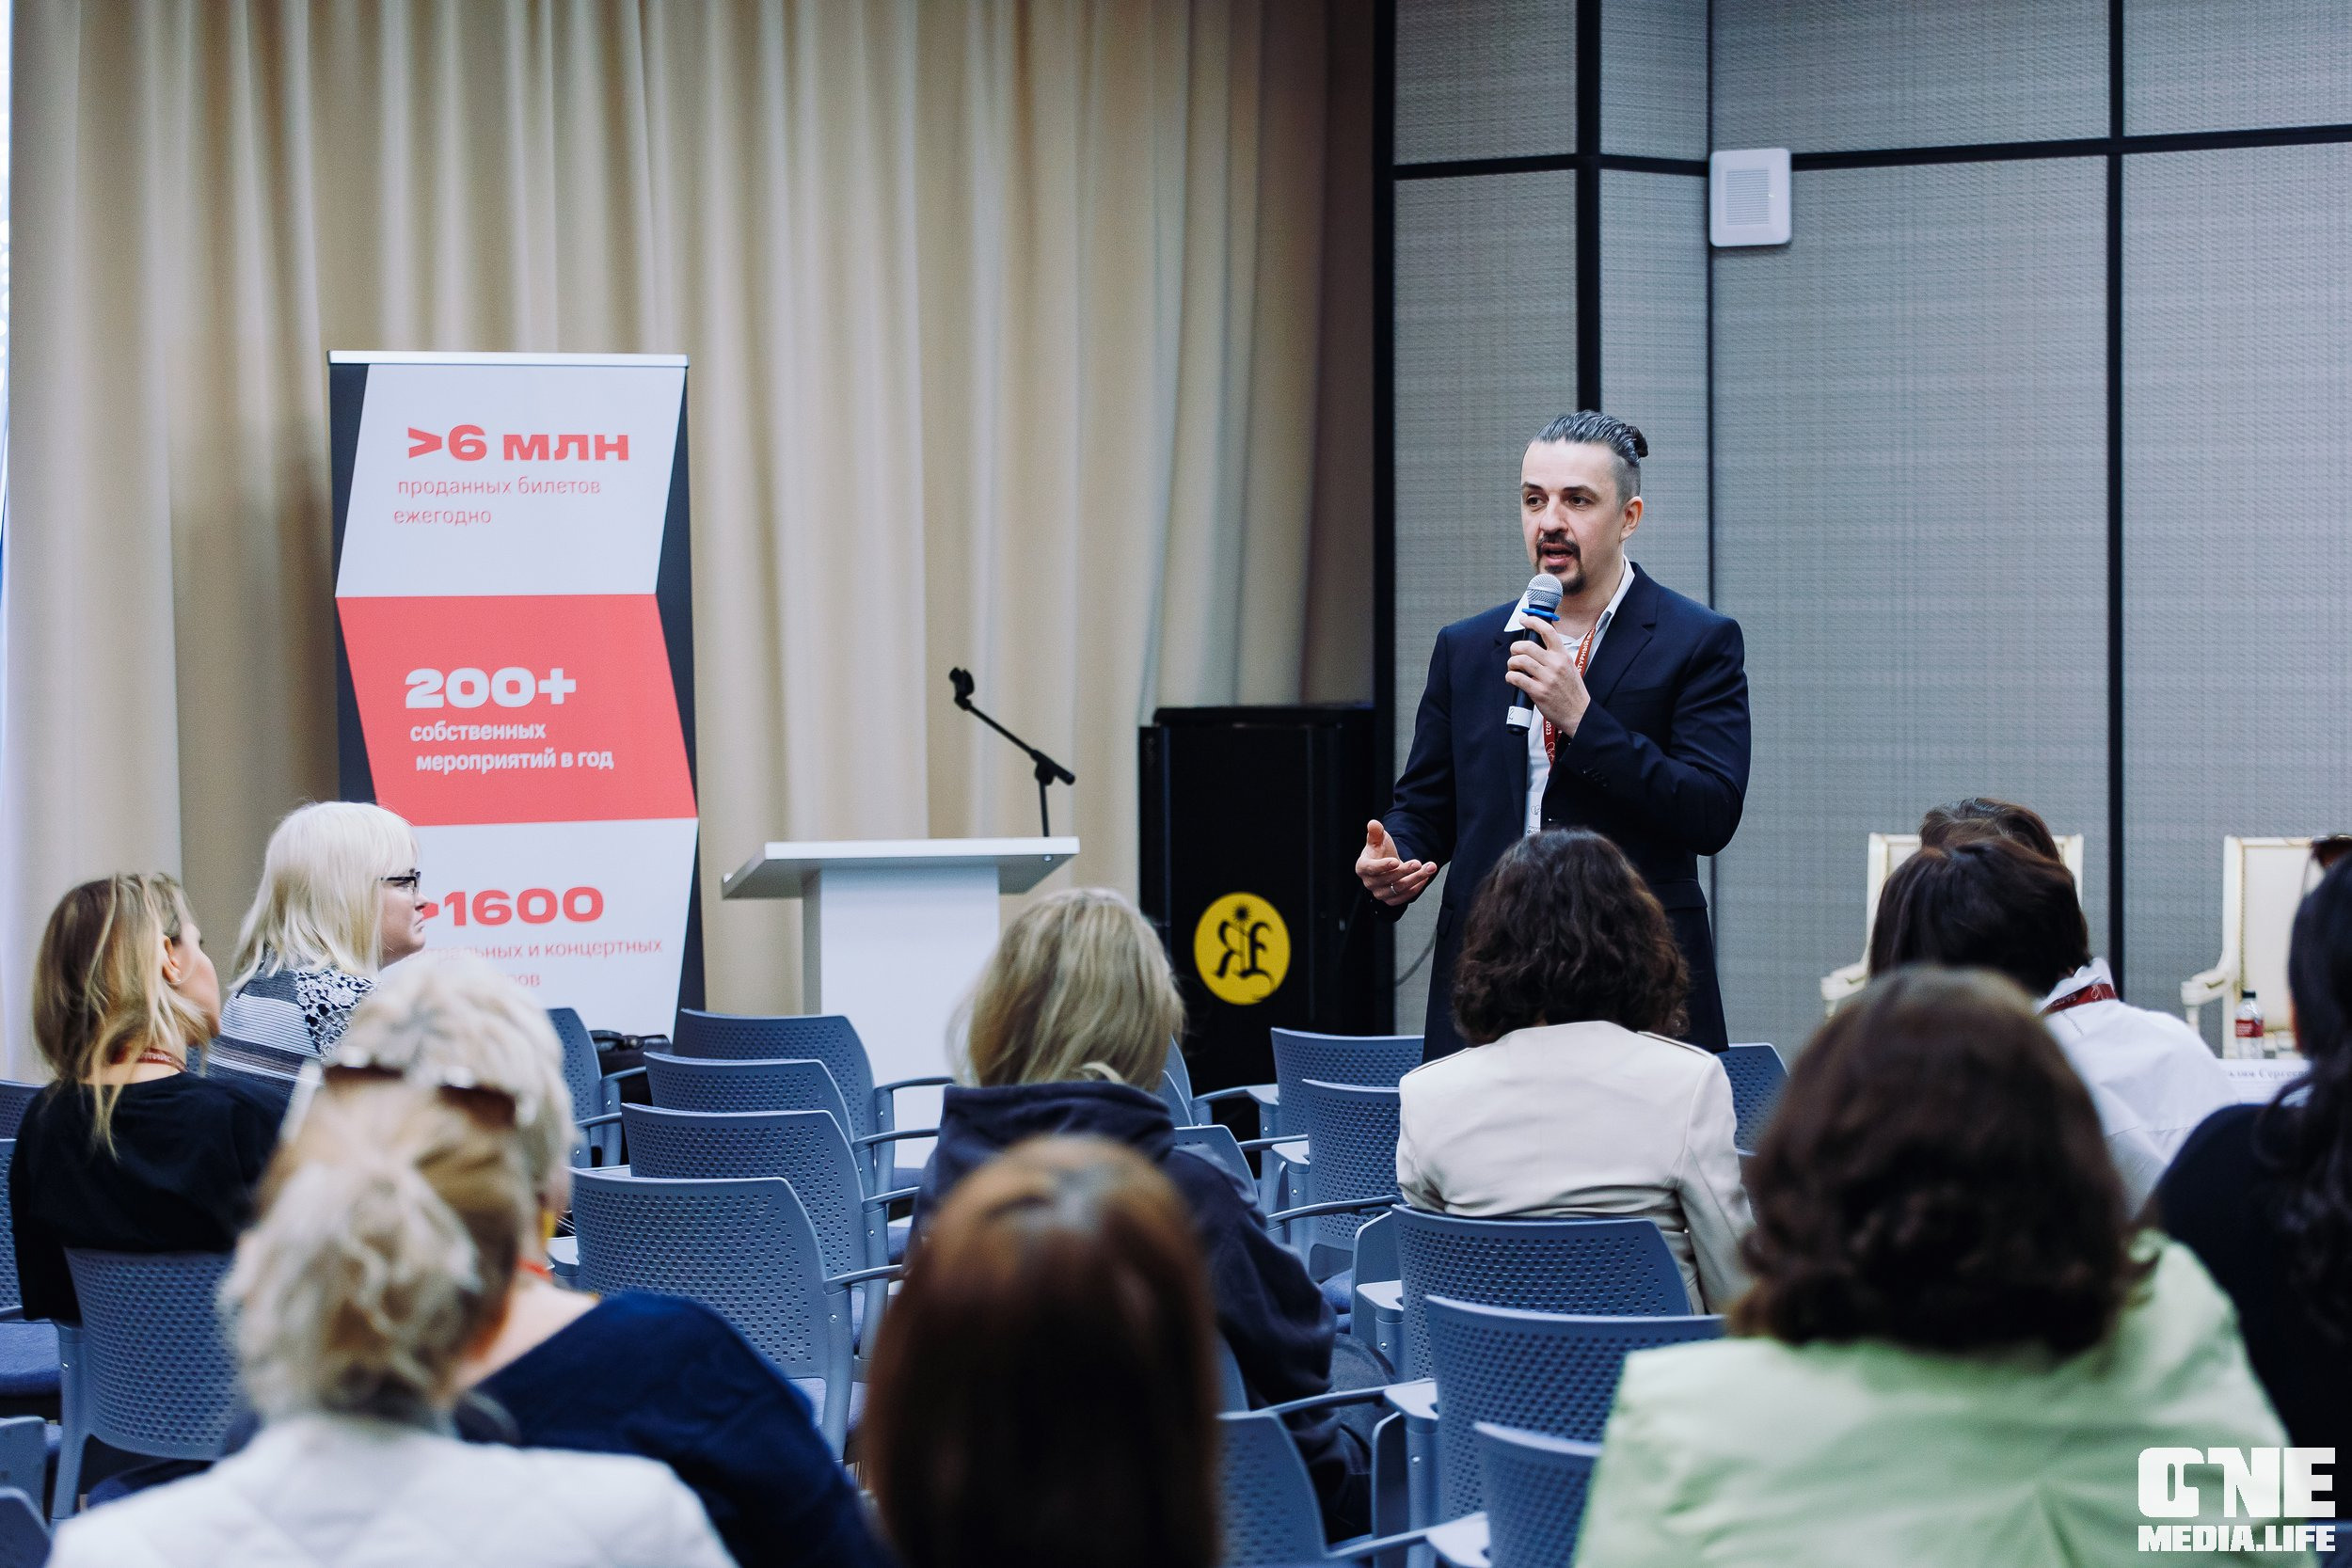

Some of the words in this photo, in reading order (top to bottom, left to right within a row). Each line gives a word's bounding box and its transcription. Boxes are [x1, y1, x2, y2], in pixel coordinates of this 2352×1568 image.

[407, 424, 487, 461] >6
[502, 434, 629, 461] млн
[398, 478, 511, 498] проданных
[517, 476, 600, 495] билетов
[393, 508, 491, 526] ежегодно
[405, 666, 577, 709] 200+
[410, 721, 547, 741] собственных
[416, 748, 556, 775] мероприятий
[561, 753, 574, 768] в
[578, 750, 614, 770] год
[528, 944, 539, 958] и
[545, 939, 663, 959] концертных
